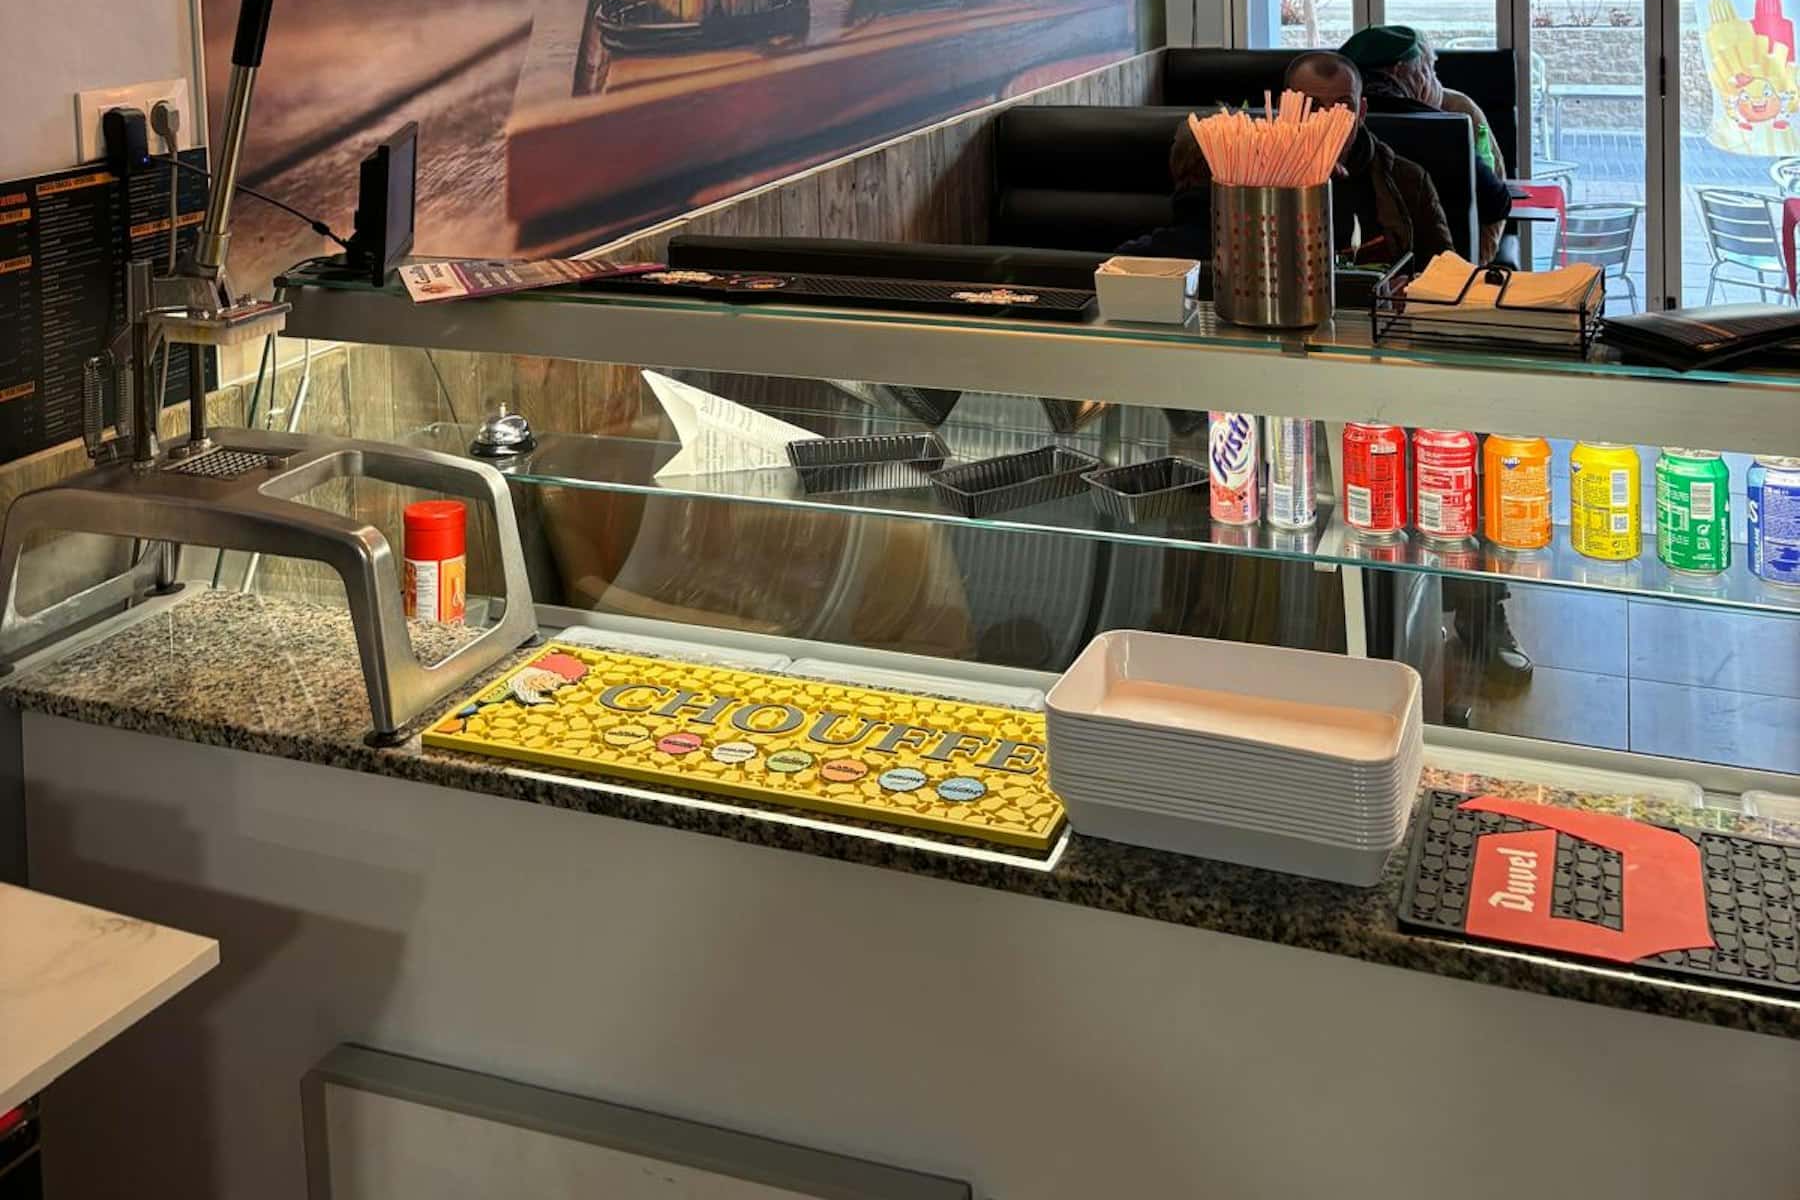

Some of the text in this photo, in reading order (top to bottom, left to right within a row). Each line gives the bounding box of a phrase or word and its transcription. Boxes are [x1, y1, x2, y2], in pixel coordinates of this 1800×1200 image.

[1212, 414, 1249, 483] Fristi
[599, 683, 1046, 775] CHOUFFE
[1488, 847, 1538, 912] Duvel
